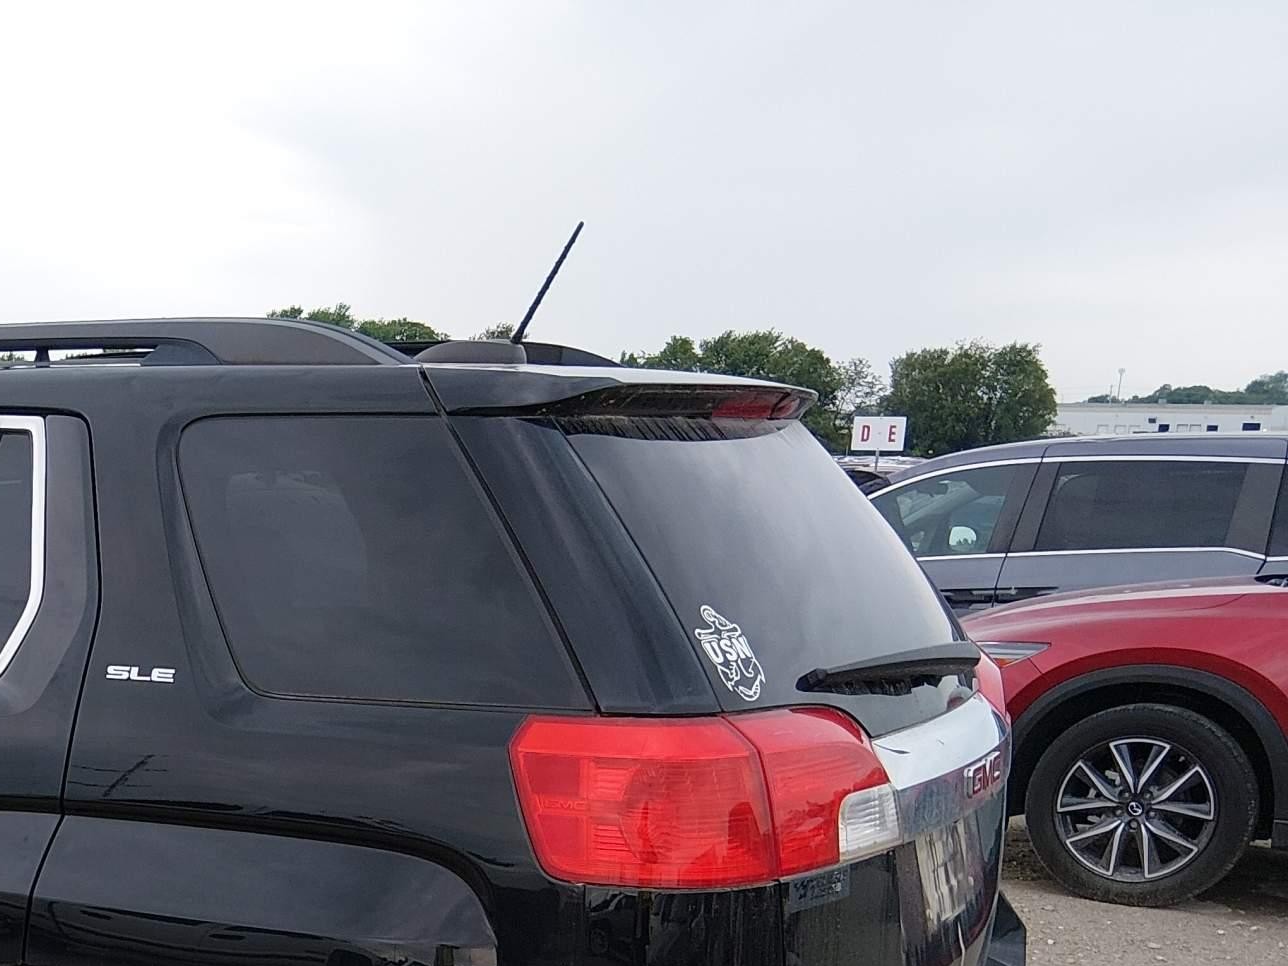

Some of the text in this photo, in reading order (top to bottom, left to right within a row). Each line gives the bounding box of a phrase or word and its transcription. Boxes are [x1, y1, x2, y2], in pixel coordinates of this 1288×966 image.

[860, 424, 898, 443] D E
[703, 636, 753, 664] USN
[105, 665, 176, 683] SLE
[965, 752, 1001, 797] GMC
